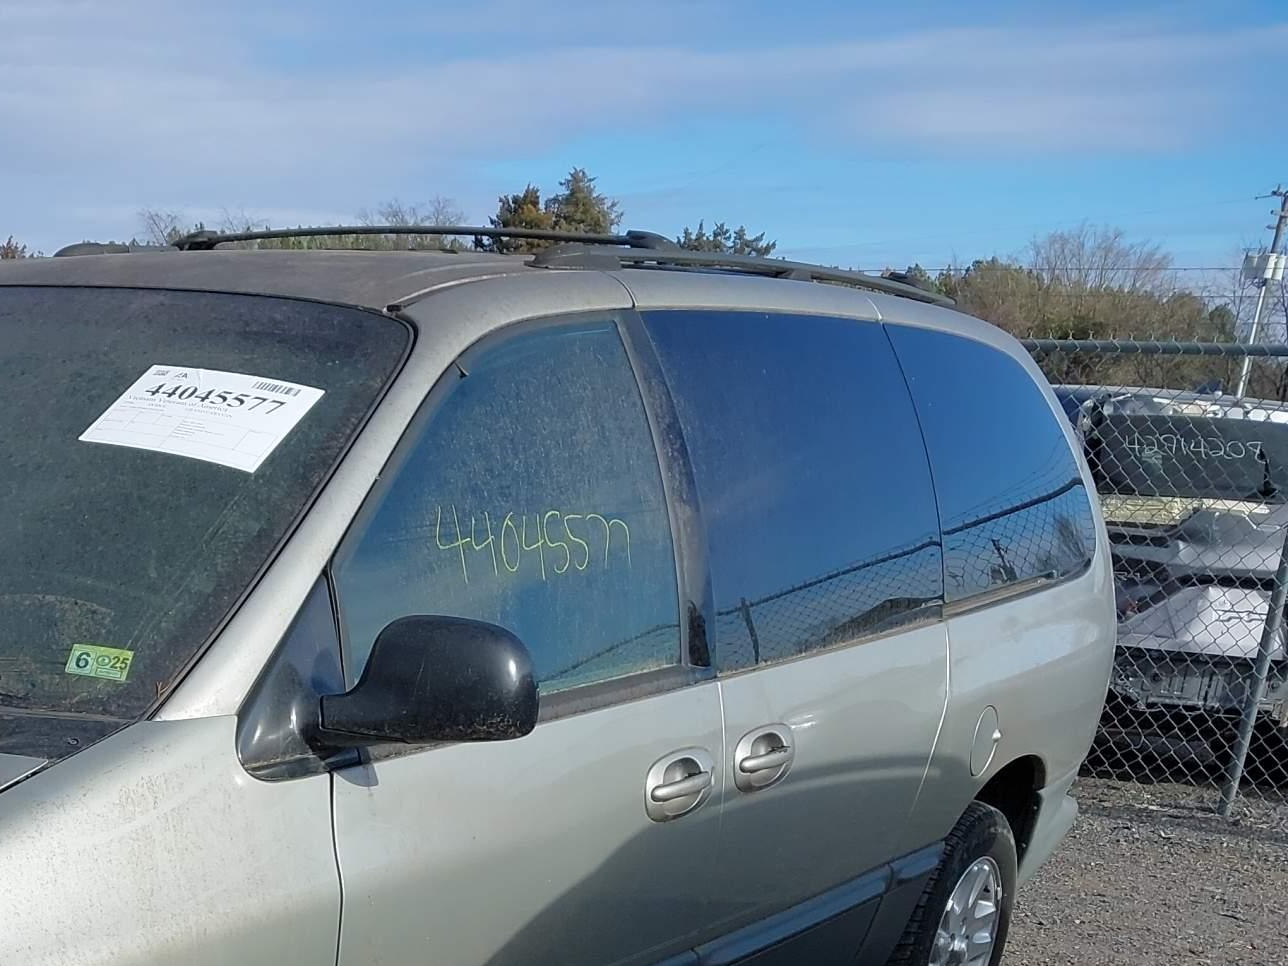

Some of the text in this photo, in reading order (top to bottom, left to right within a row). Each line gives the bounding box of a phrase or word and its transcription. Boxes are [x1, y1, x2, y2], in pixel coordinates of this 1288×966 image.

[145, 382, 287, 415] 44045577
[436, 503, 632, 584] 44045577
[75, 652, 130, 671] 6 25
